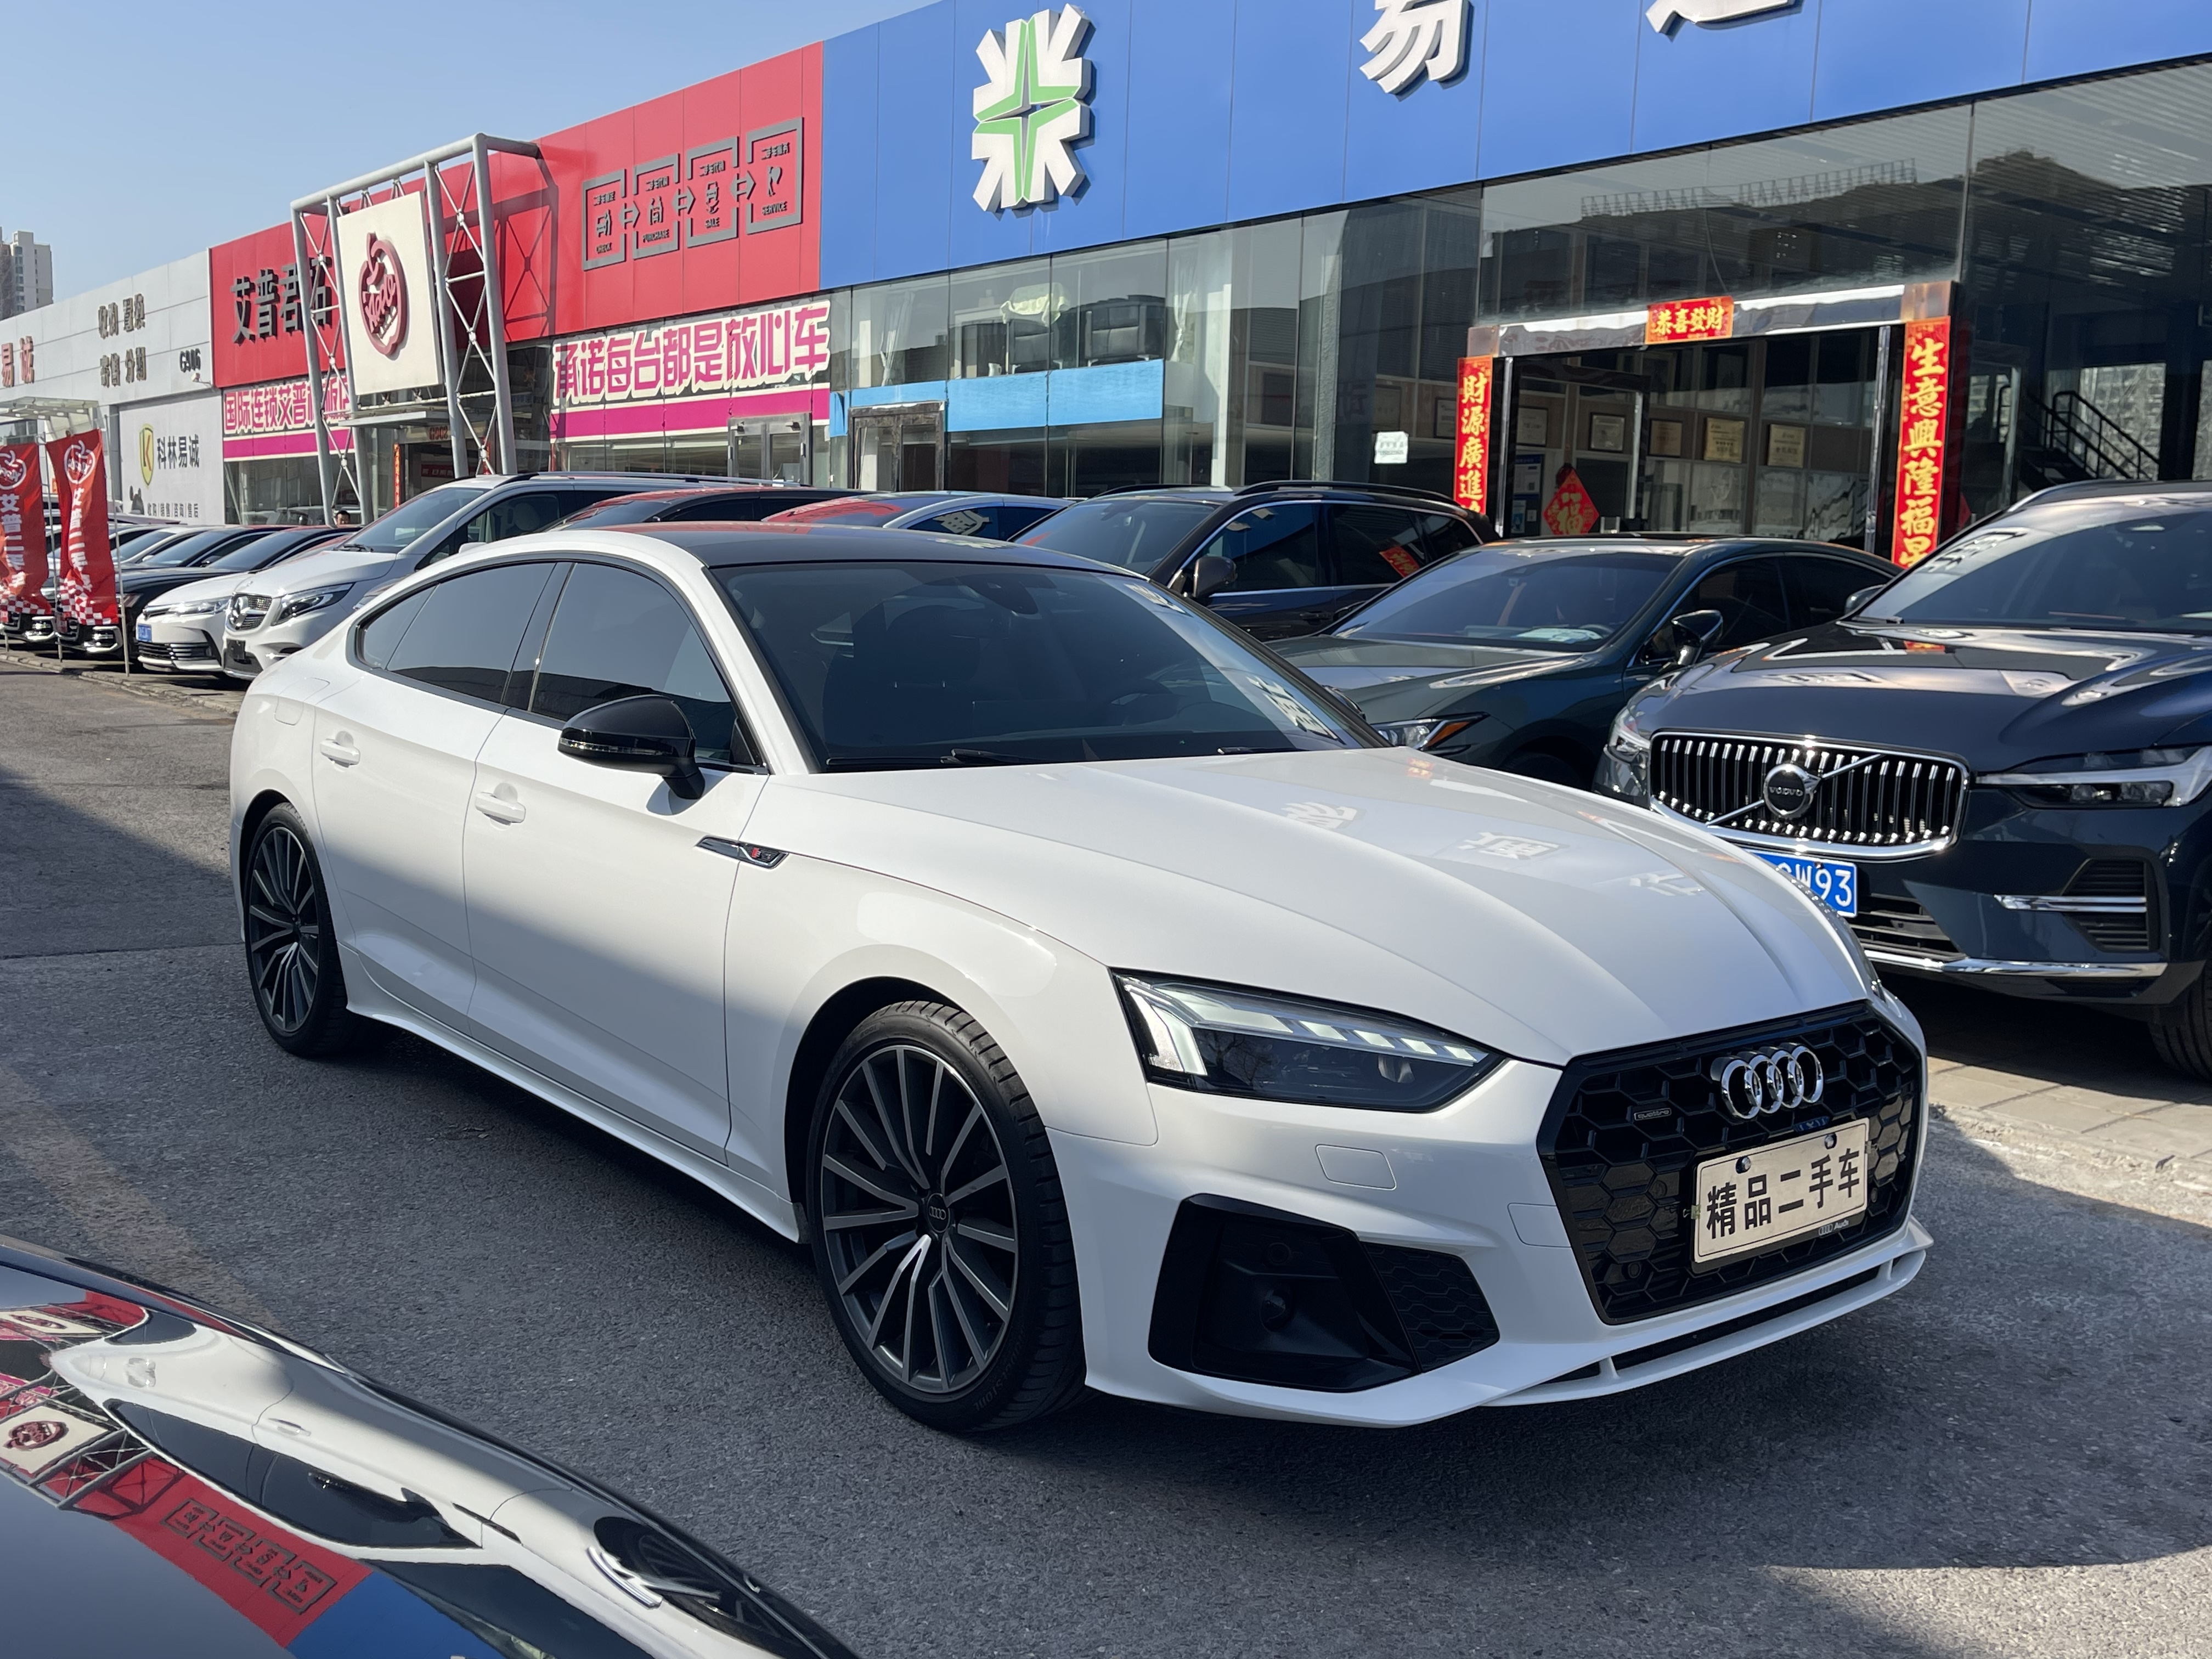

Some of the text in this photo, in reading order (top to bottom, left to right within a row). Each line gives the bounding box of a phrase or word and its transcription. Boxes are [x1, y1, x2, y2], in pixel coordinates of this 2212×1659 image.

[762, 201, 787, 216] SERVICE
[706, 217, 720, 229] SALE
[642, 229, 669, 242] PURCHASE
[1652, 305, 1724, 336] 恭喜發財
[555, 305, 829, 401] 承诺每台都是放心车
[157, 434, 200, 470] 科林易诚
[1769, 787, 1803, 797] VOLVO
[1638, 1110, 1669, 1119] quattro
[1707, 1148, 1859, 1240] 精品二手车
[1834, 1220, 1849, 1231] Audi
